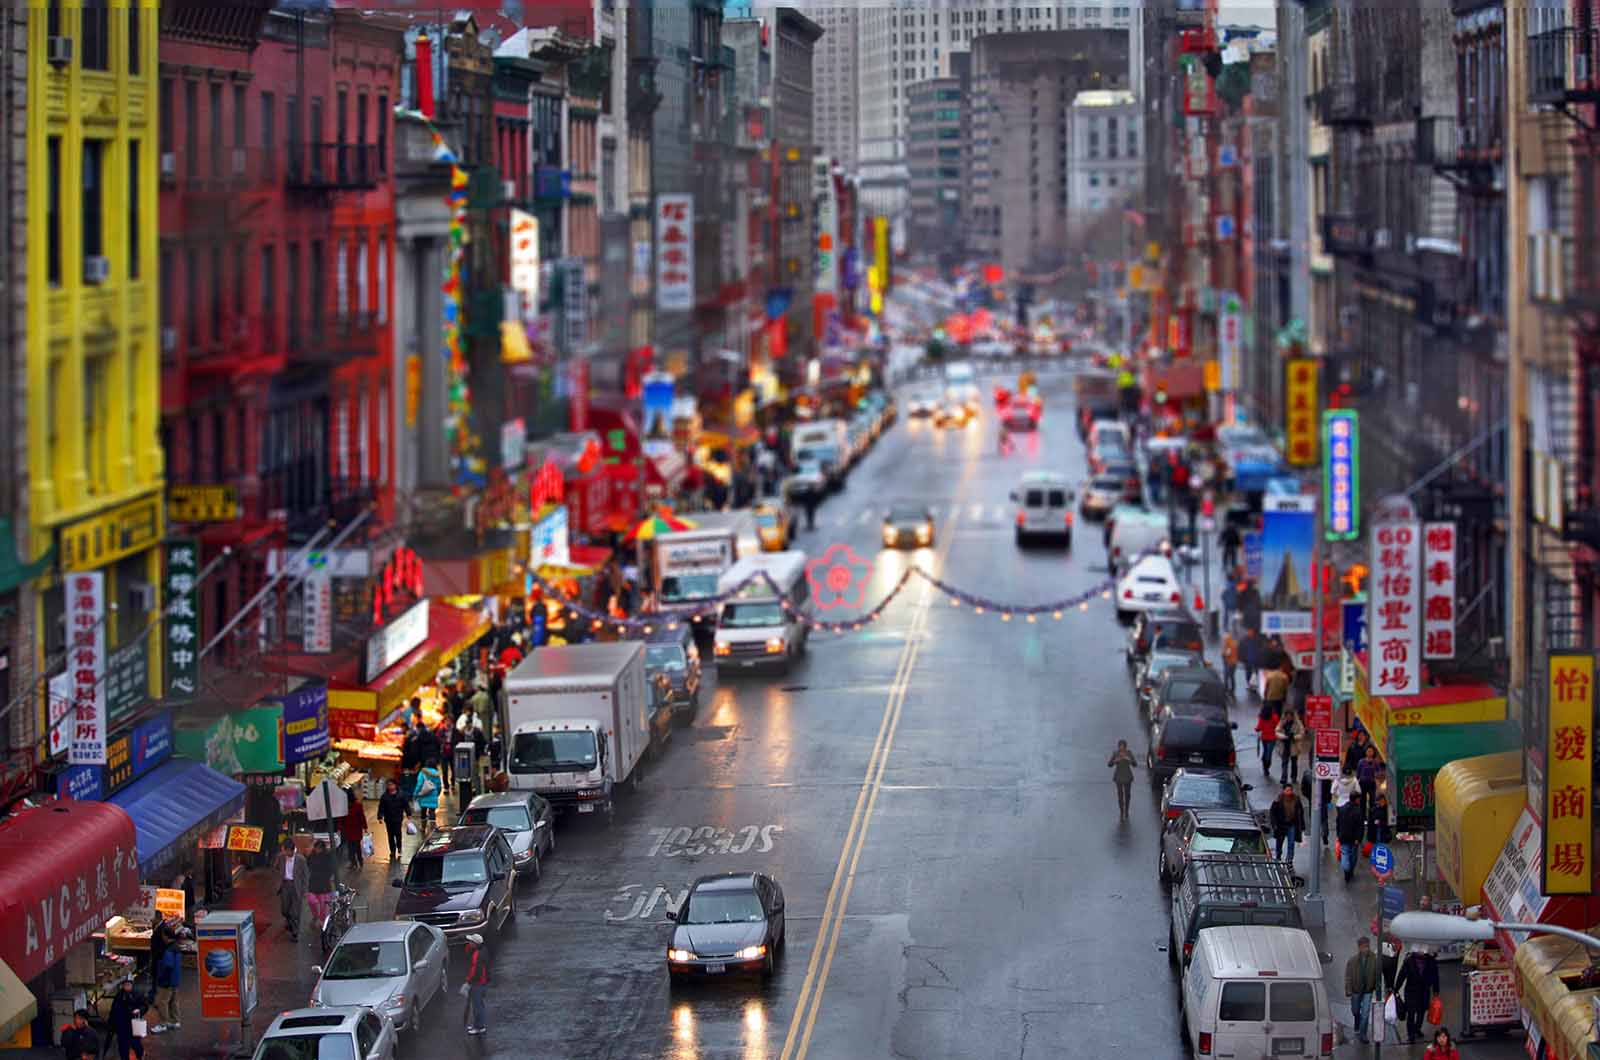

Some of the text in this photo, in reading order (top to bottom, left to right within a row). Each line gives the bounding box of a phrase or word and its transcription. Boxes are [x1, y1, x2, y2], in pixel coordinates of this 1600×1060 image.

[1551, 667, 1589, 876] 怡發商場
[25, 884, 72, 956] AVC
